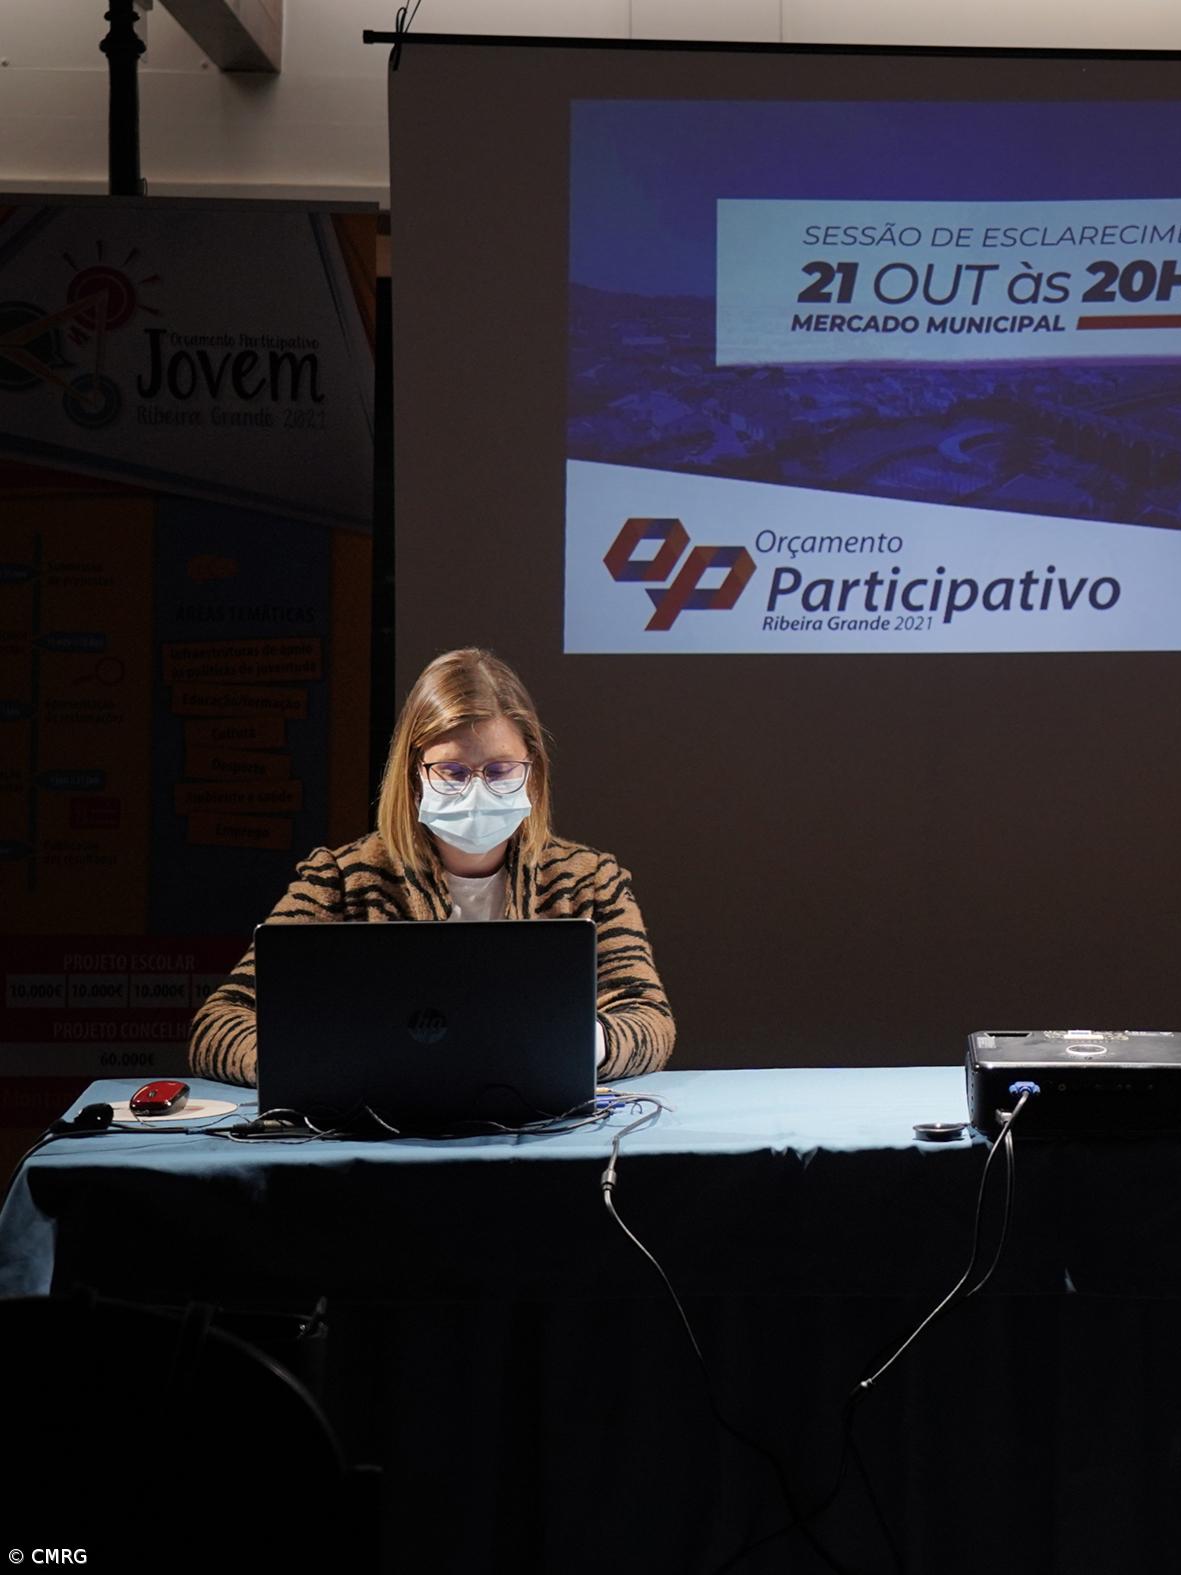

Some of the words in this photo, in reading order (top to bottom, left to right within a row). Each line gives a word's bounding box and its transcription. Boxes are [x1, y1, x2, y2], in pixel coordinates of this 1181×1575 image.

[802, 221, 922, 249] SESSÃO
[930, 226, 974, 249] DE
[797, 260, 859, 305] 21
[872, 262, 1001, 307] OUT
[1005, 257, 1072, 306] às
[790, 313, 920, 335] MERCADO
[925, 313, 1067, 335] MUNICIPAL
[136, 328, 326, 404] Jovem
[137, 405, 201, 426] Ribeira
[211, 405, 274, 427] Grande
[282, 408, 326, 429] 2021
[753, 528, 904, 560] Orçamento
[765, 565, 1123, 625] Participativo
[761, 614, 824, 632] Ribeira
[825, 614, 893, 632] Grande
[894, 614, 935, 632] 2021
[63, 953, 128, 972] PROJETO
[130, 953, 196, 972] ESCOLAR
[9, 983, 64, 999] 10.000€
[71, 983, 124, 999] 10.000€
[134, 983, 185, 999] 10.000€
[53, 1021, 117, 1040] PROJETO
[99, 1052, 155, 1068] 60.000€
